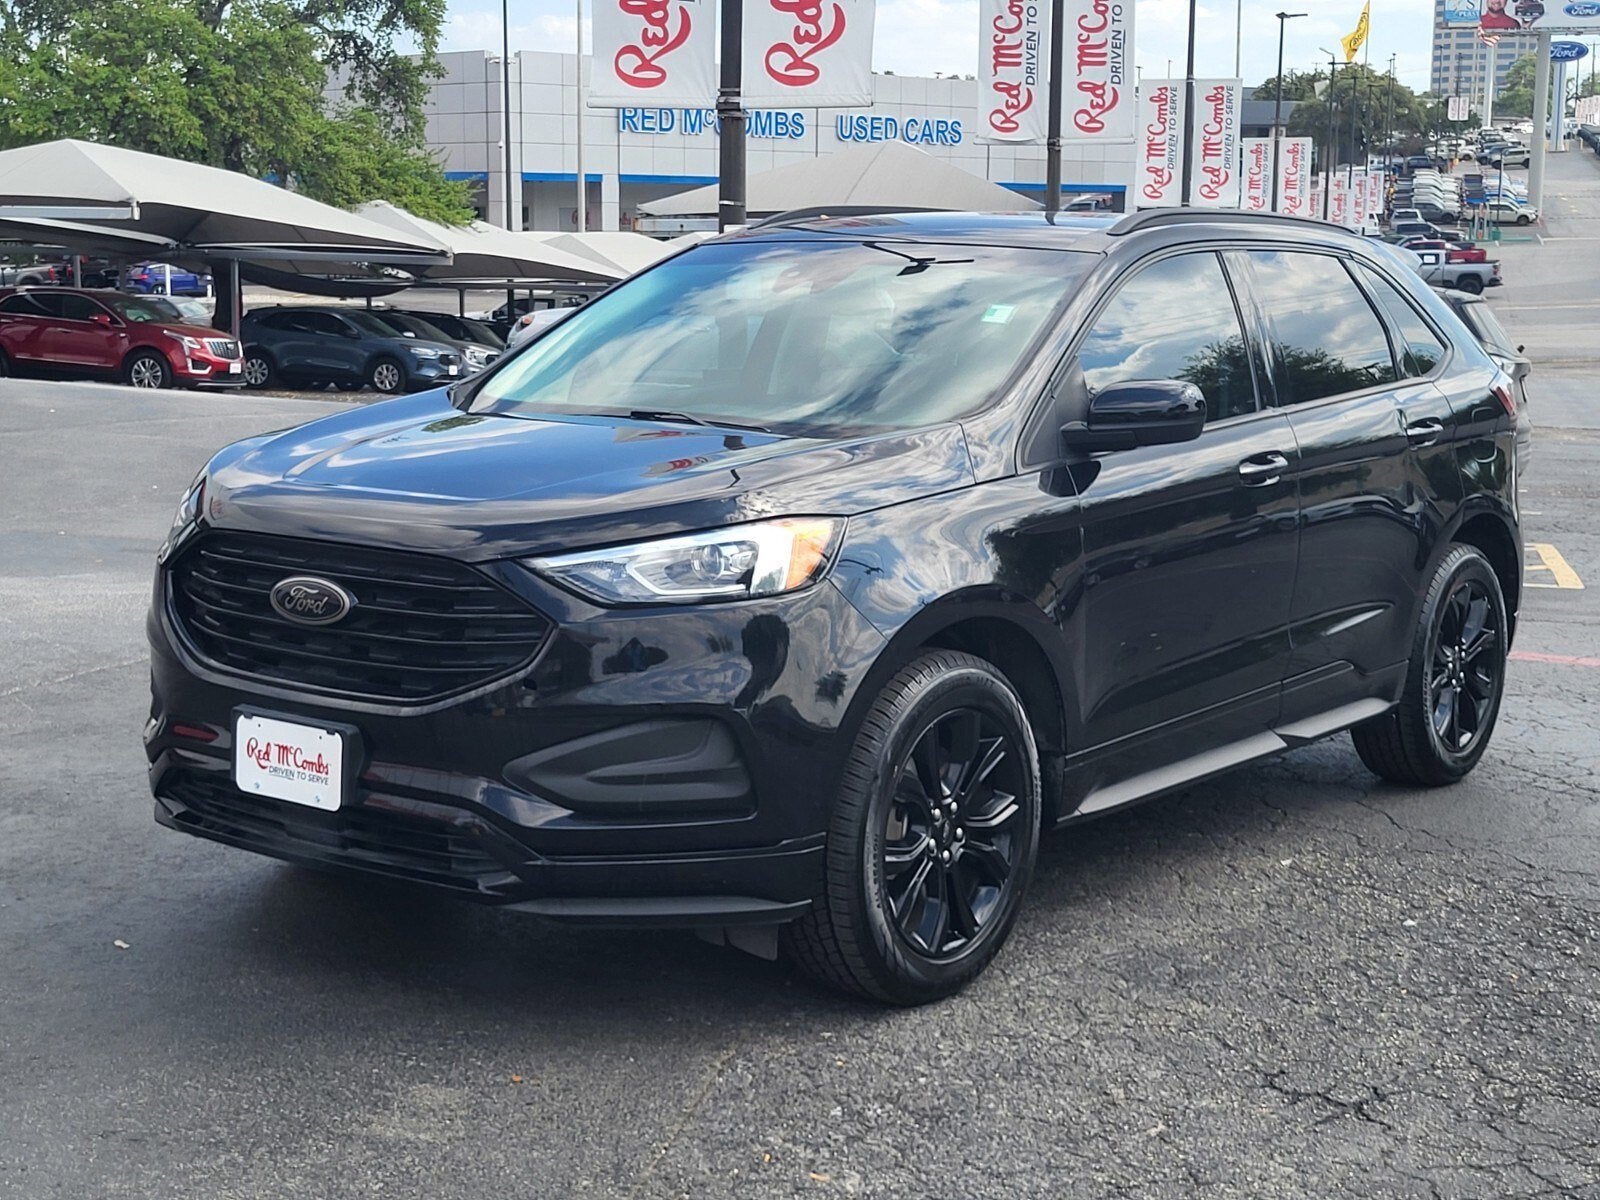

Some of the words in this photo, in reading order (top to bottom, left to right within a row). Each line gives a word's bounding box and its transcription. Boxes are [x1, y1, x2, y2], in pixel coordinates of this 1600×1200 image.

[1026, 6, 1038, 26] TO
[1112, 4, 1123, 25] TO
[1571, 4, 1598, 15] Ford
[614, 0, 691, 88] Red
[764, 0, 845, 86] Red
[1025, 31, 1037, 85] DRIVEN
[1110, 29, 1122, 85] DRIVEN
[989, 81, 1033, 133] Red
[1074, 80, 1118, 133] Red
[1169, 86, 1178, 116] SERVE
[1226, 85, 1234, 116] SERVE
[621, 107, 676, 132] RED
[683, 109, 805, 137] McMBS
[838, 115, 897, 142] USED
[904, 118, 963, 144] CARS
[1147, 86, 1168, 163] McCombs
[1169, 118, 1177, 131] TO
[1203, 85, 1225, 163] McCombs
[1225, 118, 1233, 131] TO
[1167, 134, 1177, 170] DRIVEN
[1224, 134, 1232, 169] DRIVEN
[1248, 143, 1262, 192] McCombs
[1285, 143, 1299, 192] McCombs
[1143, 166, 1172, 199] Red
[1200, 166, 1229, 199] Red
[284, 585, 329, 614] Ford
[246, 737, 272, 769] Red
[274, 743, 329, 775] McCombs
[268, 765, 295, 779] DRIVEN
[296, 771, 307, 780] TO
[308, 774, 329, 785] SERVE
